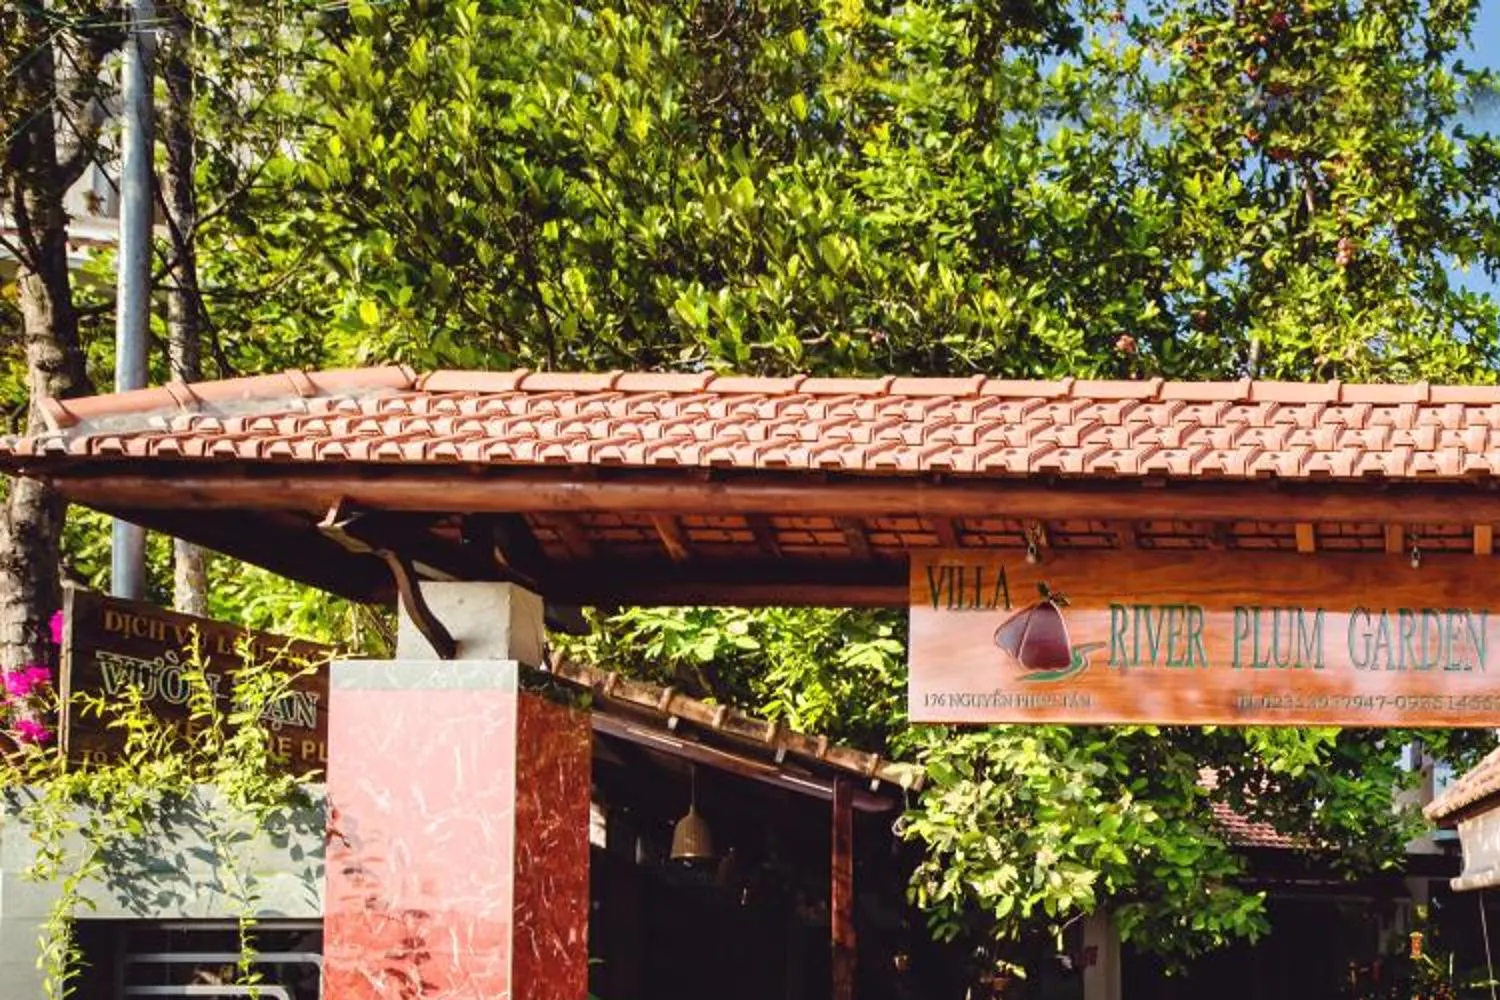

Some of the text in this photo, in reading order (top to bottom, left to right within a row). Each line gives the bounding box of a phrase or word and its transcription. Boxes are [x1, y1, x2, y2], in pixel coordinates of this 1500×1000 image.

[926, 565, 1012, 611] VILLA
[1107, 602, 1490, 672] RIVER PLUM GARDEN
